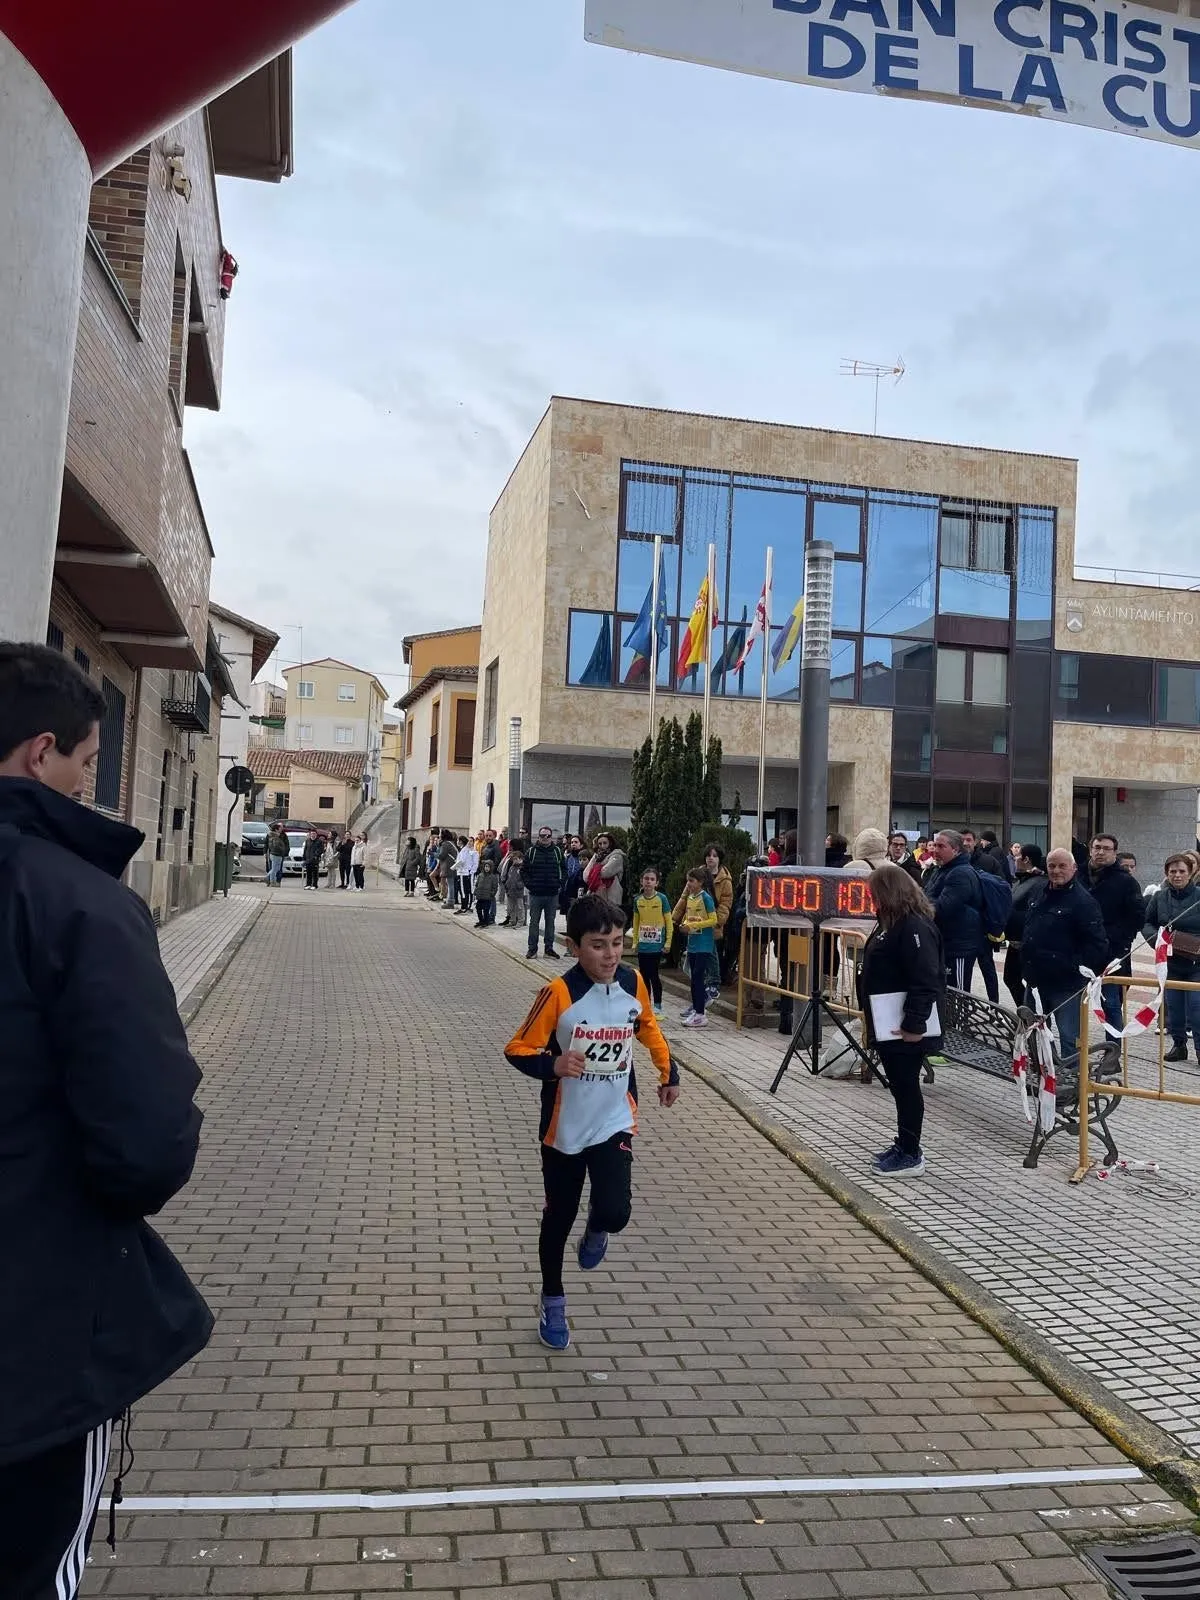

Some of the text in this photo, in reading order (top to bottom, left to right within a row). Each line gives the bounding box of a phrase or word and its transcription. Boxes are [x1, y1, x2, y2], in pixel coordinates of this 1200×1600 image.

[808, 21, 1200, 138] DE LA CU
[1092, 604, 1194, 625] AYUNTAMIENTO
[584, 1043, 623, 1062] 429
